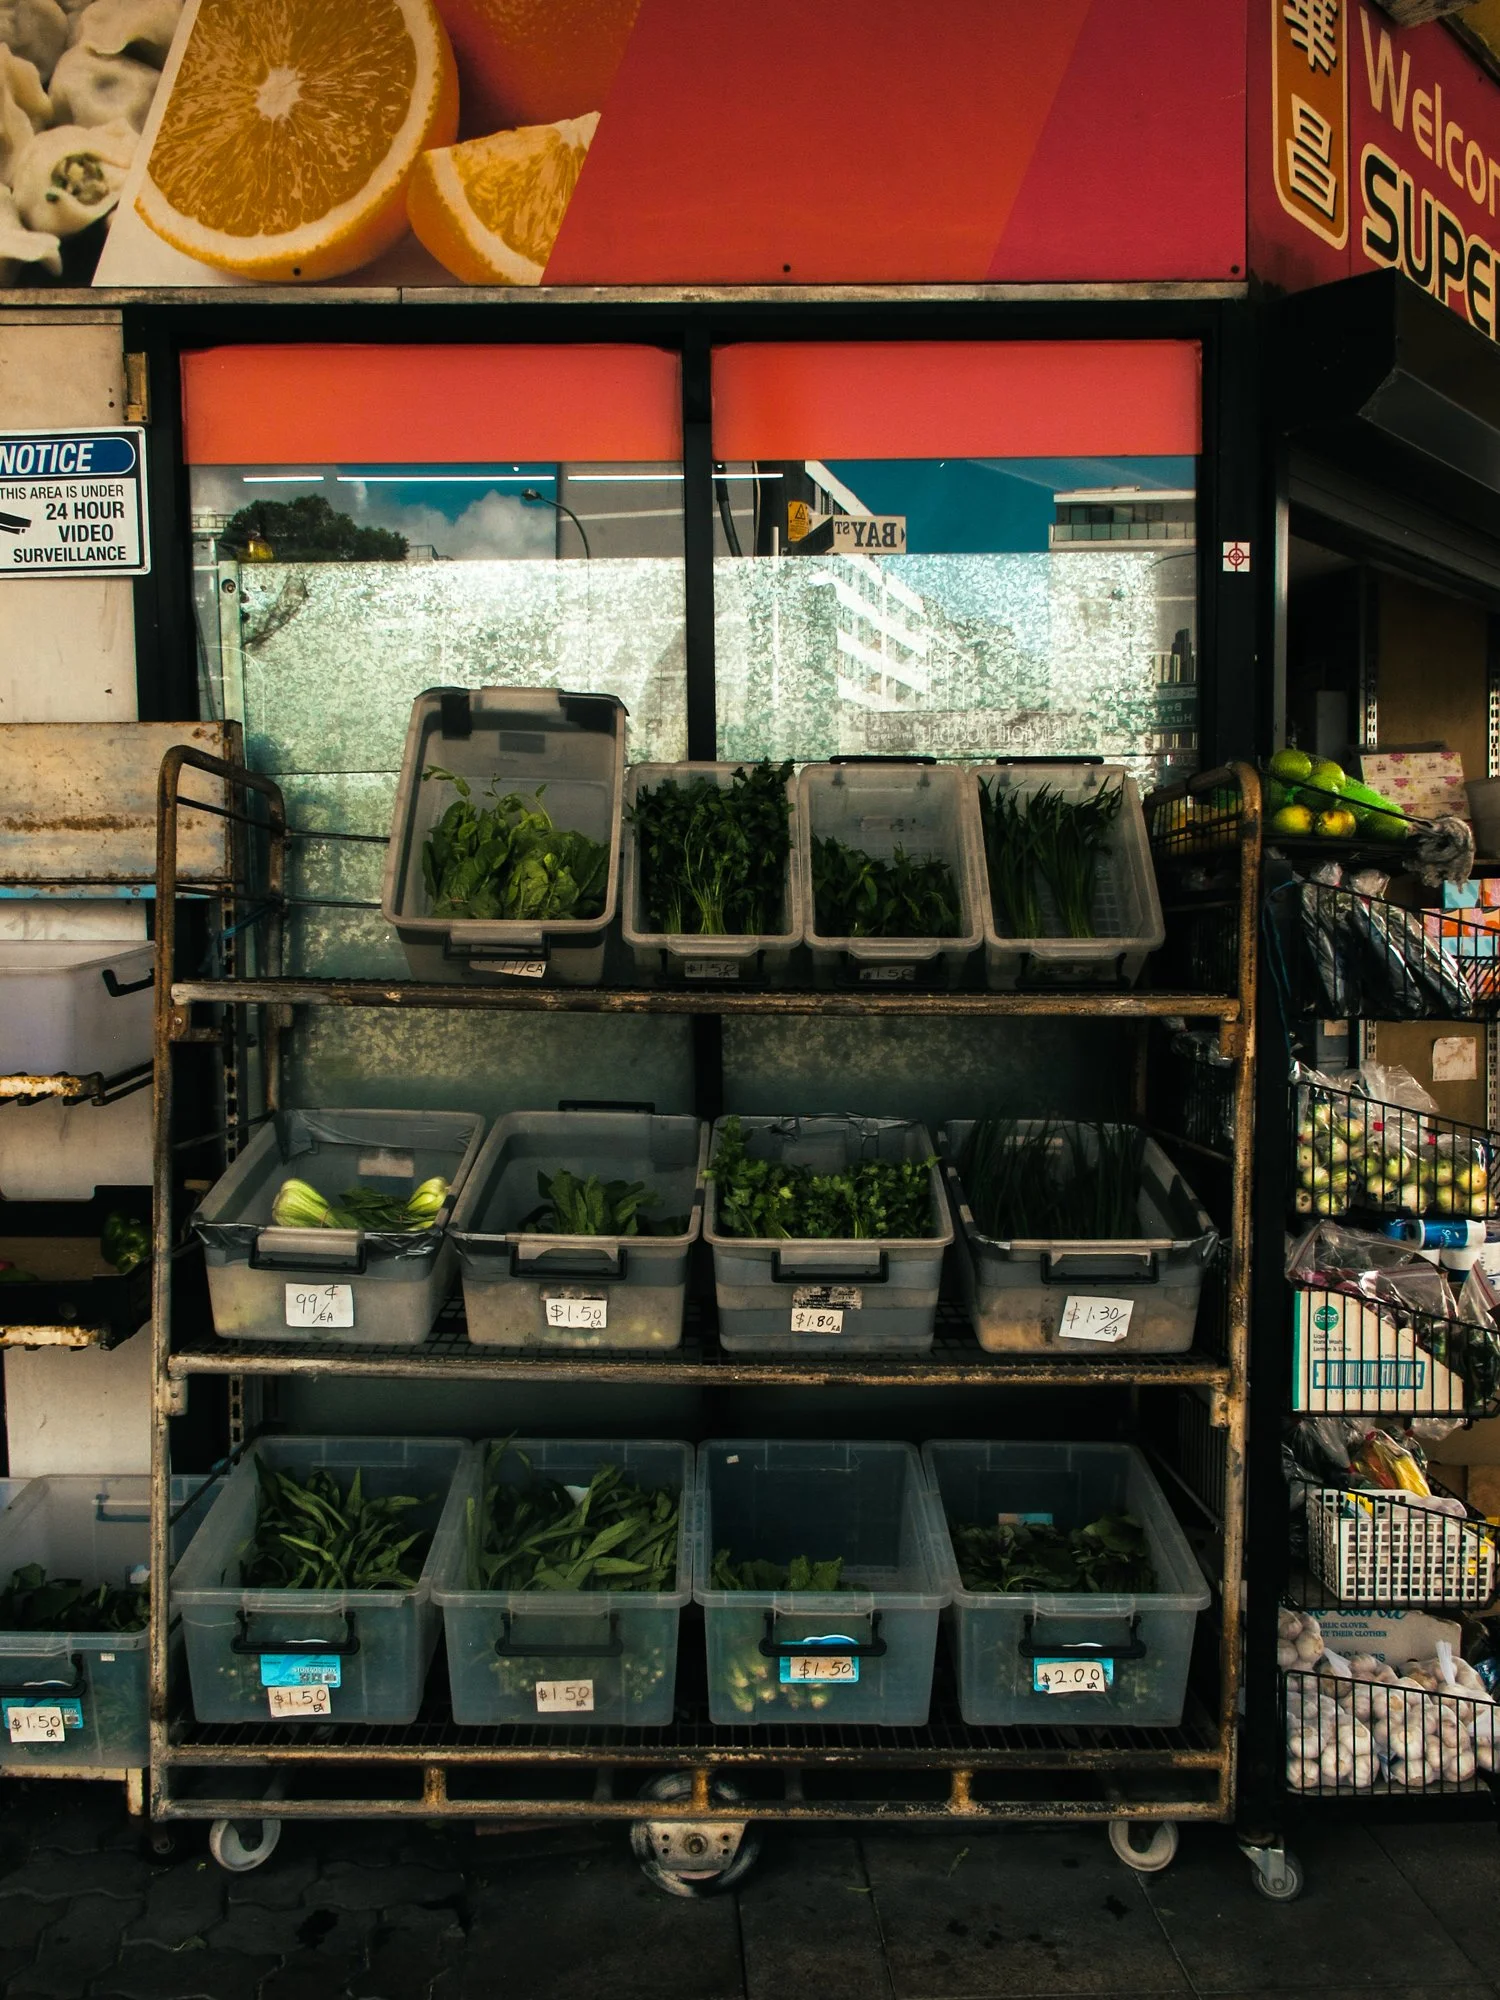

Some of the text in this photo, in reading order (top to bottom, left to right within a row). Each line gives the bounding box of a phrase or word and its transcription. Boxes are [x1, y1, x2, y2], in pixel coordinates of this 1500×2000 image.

[1360, 143, 1500, 344] SUPE
[0, 443, 94, 473] NOTICE
[0, 484, 124, 500] THIS AREA IS UNDER
[46, 501, 125, 520] 24 HOUR
[58, 523, 114, 543] VIDEO
[13, 546, 127, 563] SURVEILLANCE
[550, 1304, 602, 1322] $1.50
[795, 1312, 835, 1328] $1.80
[1066, 1302, 1119, 1330] $1.30
[800, 1659, 852, 1679] $1.50
[1042, 1668, 1100, 1685] $2.00
[274, 1689, 327, 1709] $1.50
[539, 1686, 590, 1701] $1.50
[12, 1715, 61, 1733] $1.50
